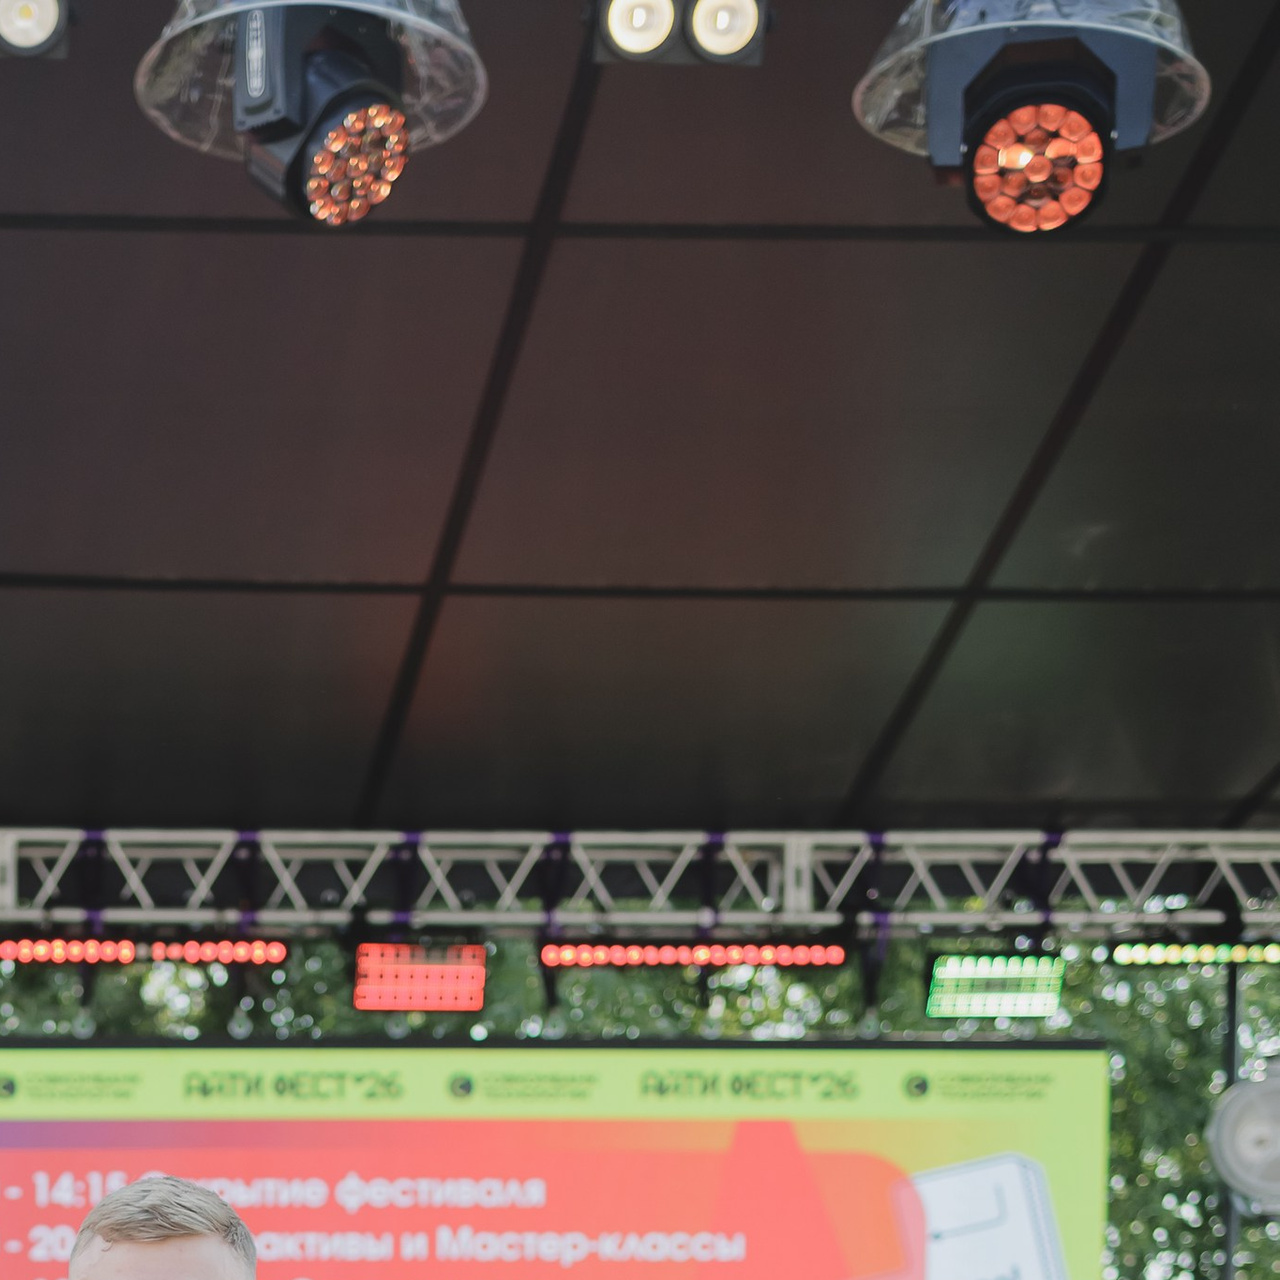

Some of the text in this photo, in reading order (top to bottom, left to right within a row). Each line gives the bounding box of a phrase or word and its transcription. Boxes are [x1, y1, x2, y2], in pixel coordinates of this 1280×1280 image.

[334, 1171, 547, 1215] фестиваля
[400, 1232, 429, 1261] и
[436, 1225, 747, 1269] Мастер-классы
